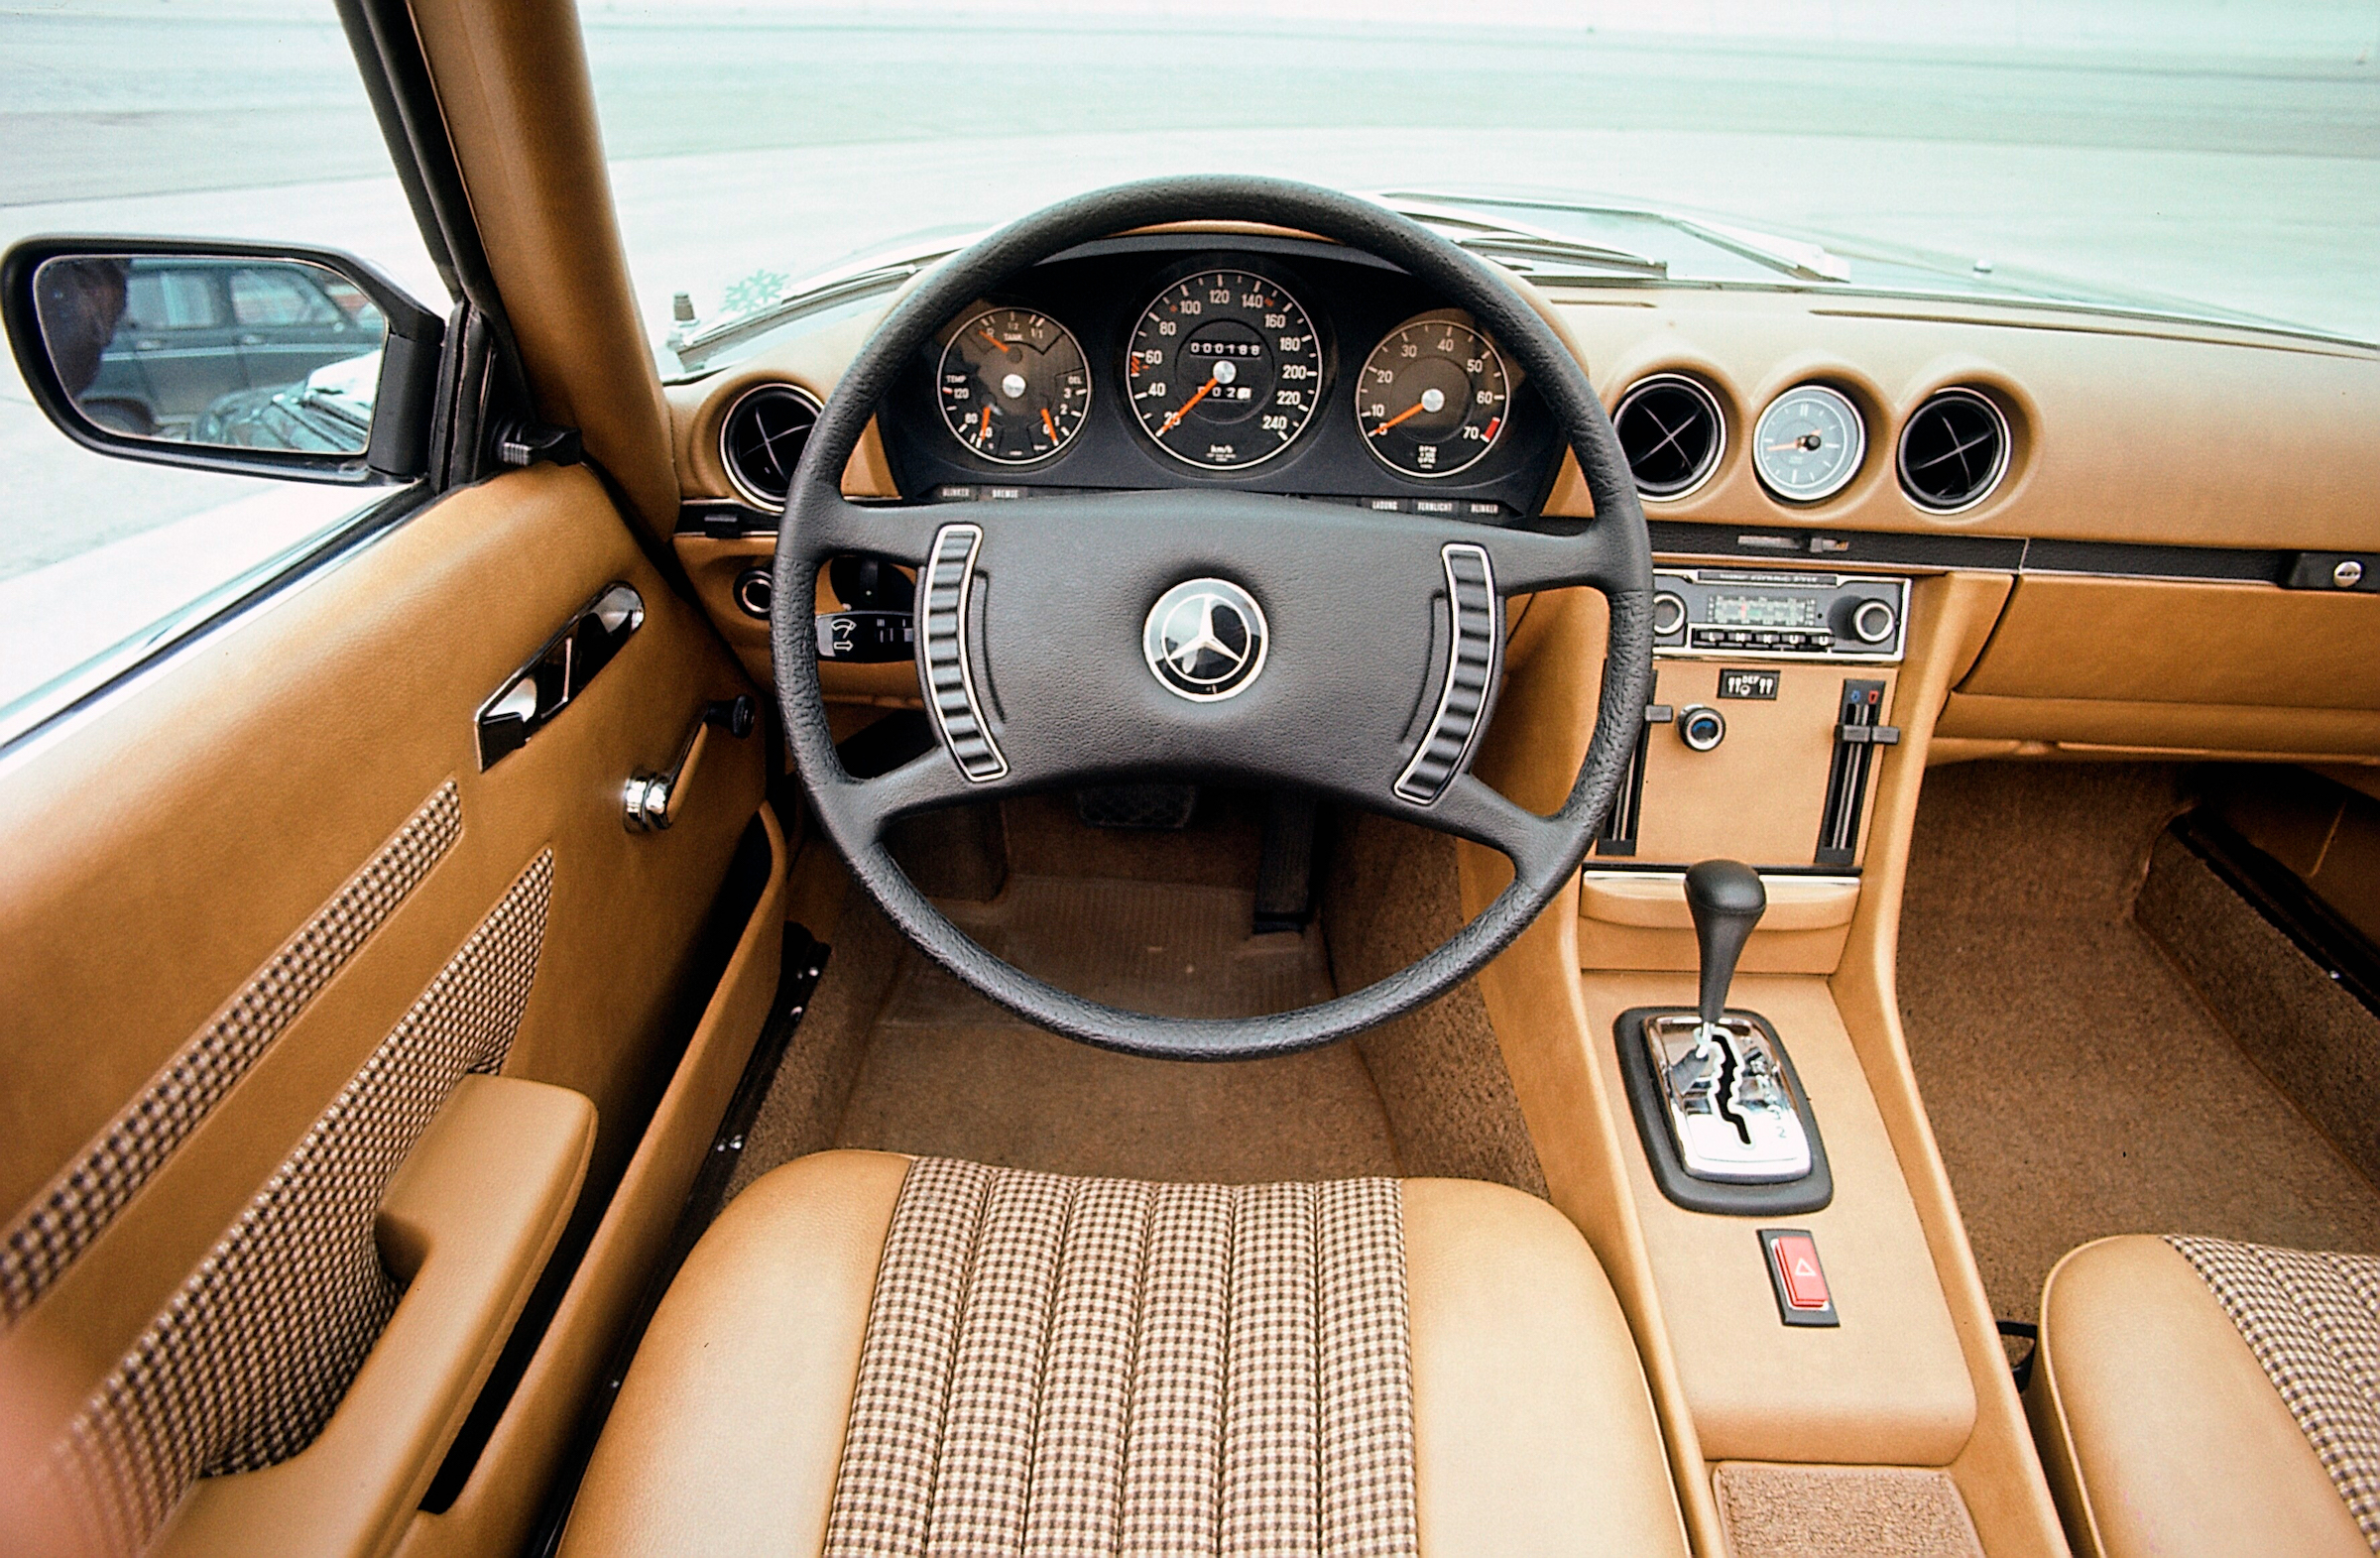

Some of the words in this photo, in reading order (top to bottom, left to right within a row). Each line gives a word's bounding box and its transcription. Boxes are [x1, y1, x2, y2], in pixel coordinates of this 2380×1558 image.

[1210, 290, 1230, 304] 120
[1242, 295, 1263, 308] 140
[1180, 300, 1201, 314] 100
[1264, 314, 1286, 328] 160
[1159, 321, 1176, 335] 80
[1003, 332, 1023, 341] TANK
[1279, 337, 1301, 351] 180
[1438, 339, 1454, 352] 40
[1145, 350, 1162, 364] 60
[1401, 345, 1417, 358] 30
[1467, 359, 1483, 373] 50
[946, 375, 967, 384] TEMP
[1282, 366, 1307, 380] 200
[1376, 370, 1393, 384] 20
[954, 388, 969, 399] 120
[1064, 388, 1071, 399] 3
[1147, 383, 1166, 397] 40
[1276, 391, 1301, 405] 220
[1477, 391, 1492, 405] 60
[1060, 404, 1068, 415] 2
[1371, 404, 1384, 417] 10
[965, 413, 978, 424] 80
[1054, 416, 1060, 426] 1
[1262, 416, 1287, 429] 240
[1463, 426, 1480, 439] 70
[1763, 634, 1772, 644] K
[1789, 635, 1798, 644] U
